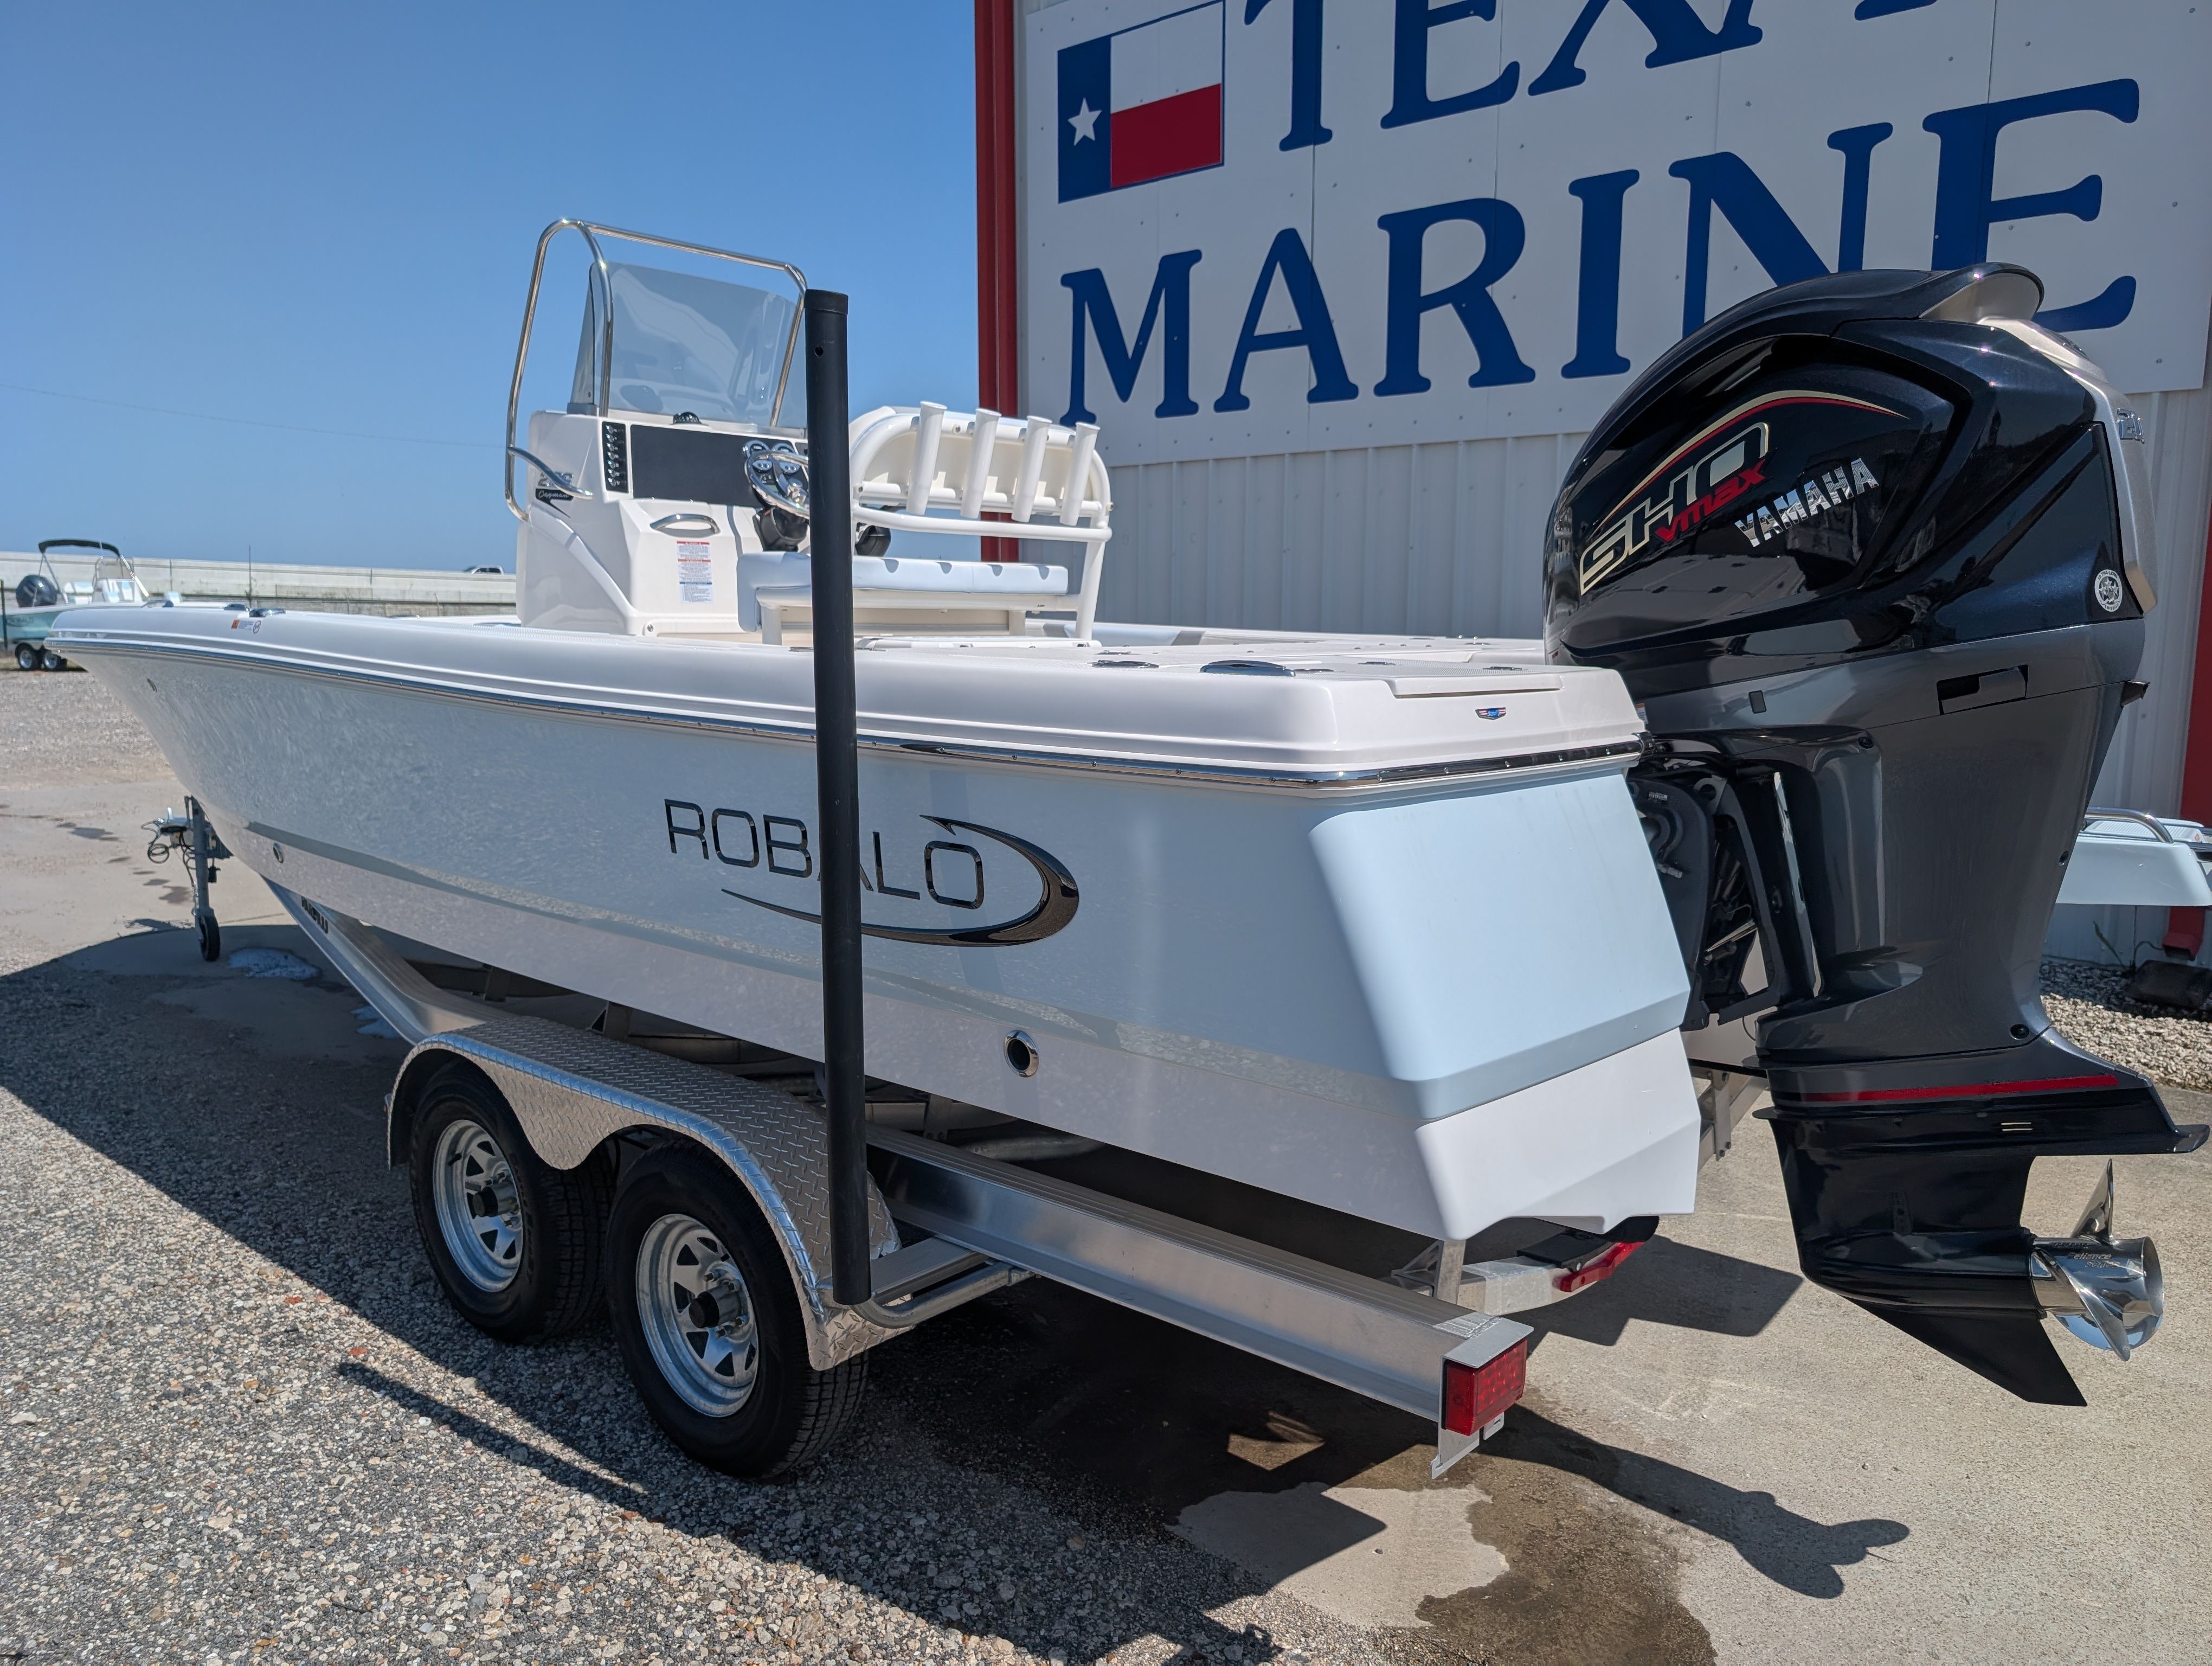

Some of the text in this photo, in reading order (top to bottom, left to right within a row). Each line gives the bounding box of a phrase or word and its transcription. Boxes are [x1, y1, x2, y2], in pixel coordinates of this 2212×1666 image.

[1059, 78, 2140, 427] MARINE
[1580, 422, 1769, 595] SHO
[1734, 457, 1880, 548] YAMAHA
[664, 798, 985, 910] ROBLO
